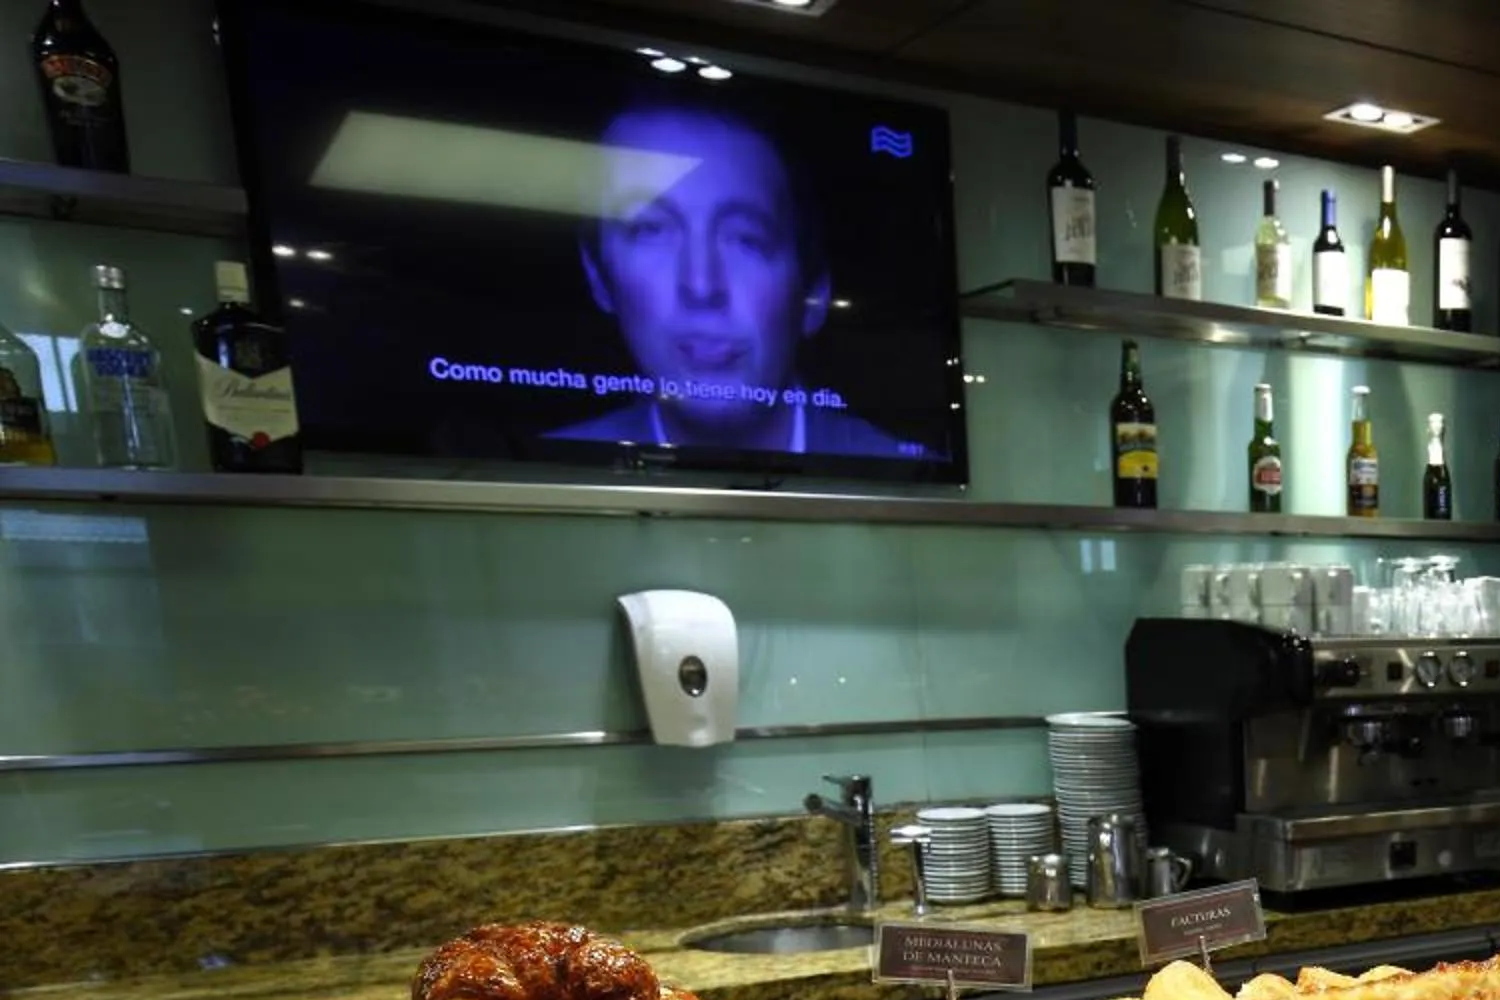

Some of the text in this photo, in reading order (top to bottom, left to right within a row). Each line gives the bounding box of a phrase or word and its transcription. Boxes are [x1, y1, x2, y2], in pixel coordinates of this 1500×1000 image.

[429, 356, 503, 383] Como
[509, 367, 588, 389] mucha
[592, 373, 655, 395] gente
[660, 376, 678, 396] lo
[685, 379, 736, 400] tiene
[741, 383, 778, 407] hoy
[783, 388, 807, 405] en
[904, 935, 1003, 952] MEDIALUNAS
[903, 950, 1001, 968] DE MANTECA
